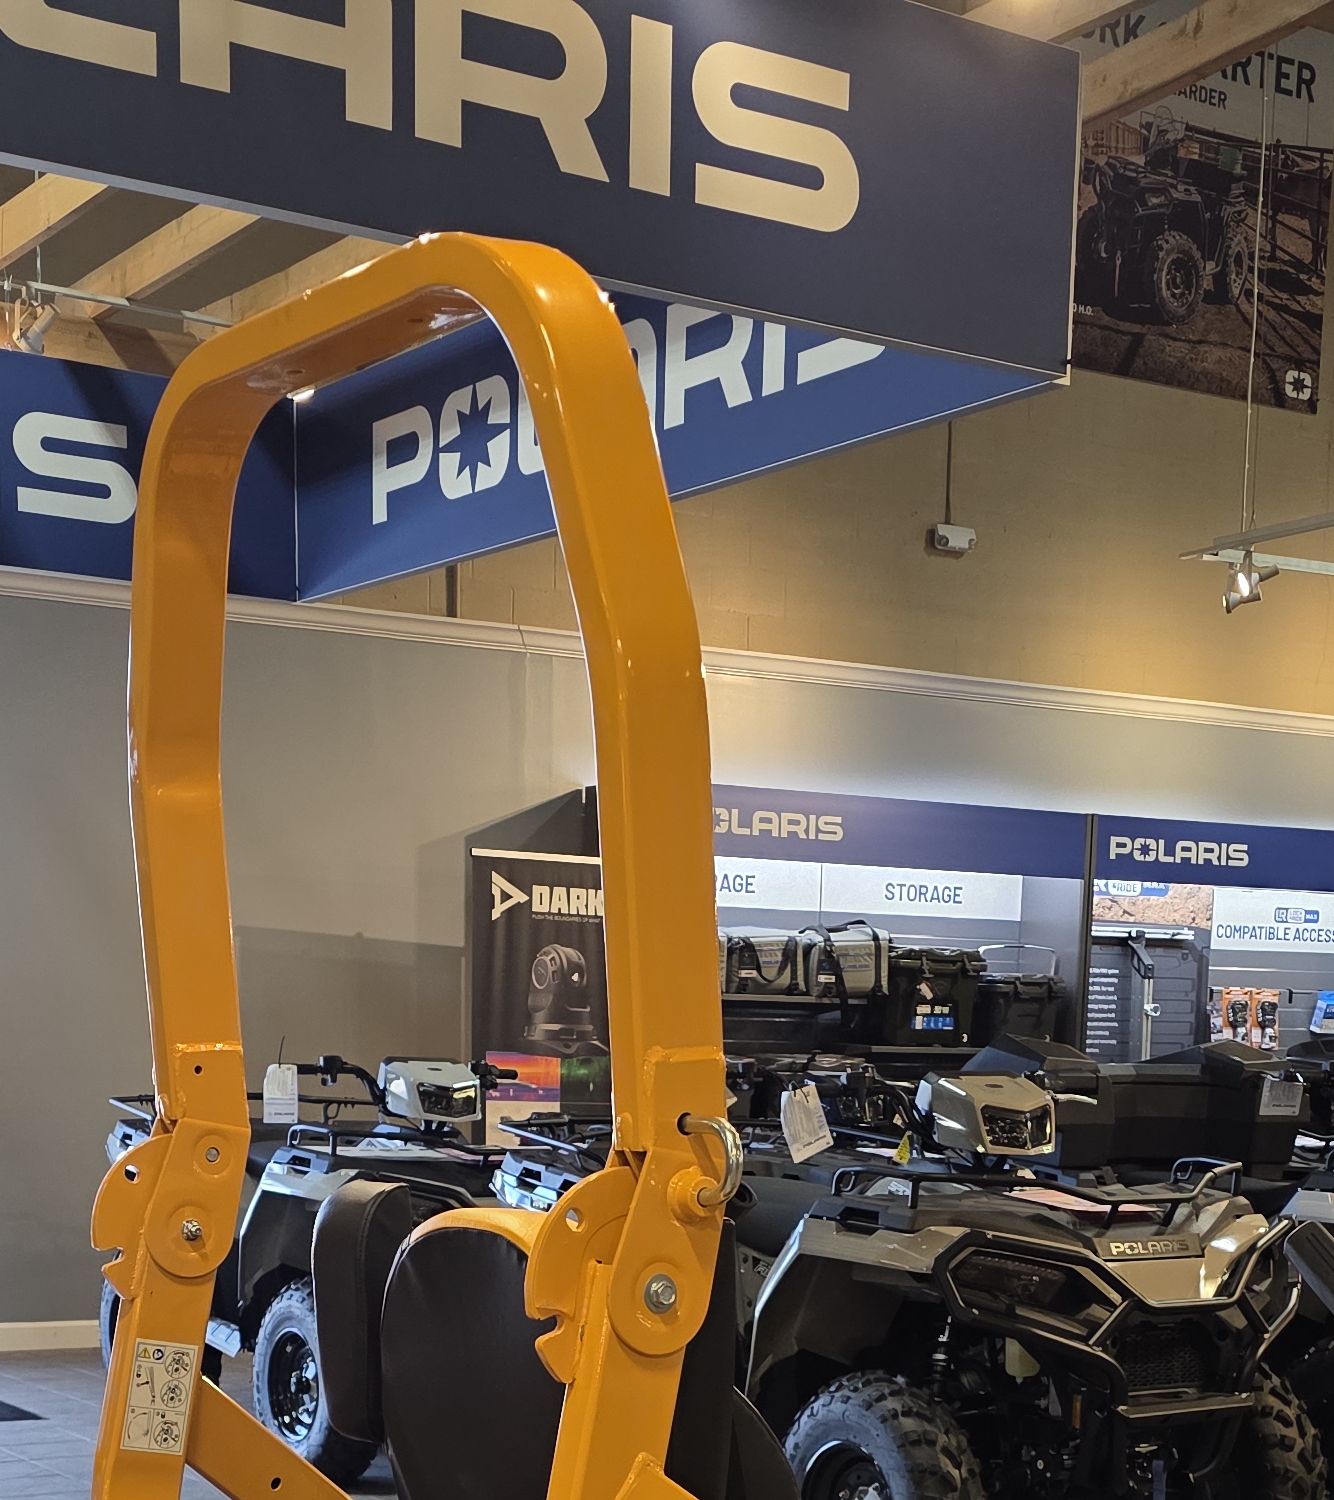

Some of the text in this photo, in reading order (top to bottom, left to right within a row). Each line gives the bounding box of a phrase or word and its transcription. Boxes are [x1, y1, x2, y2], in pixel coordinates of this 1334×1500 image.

[1173, 83, 1227, 110] ARDER
[713, 807, 844, 842] OLARIS
[1109, 836, 1250, 867] POLARIS
[532, 885, 604, 917] DARK
[884, 882, 964, 905] STORAGE
[1216, 924, 1291, 942] COMPATIBLE
[1109, 1238, 1190, 1256] POLARIS
